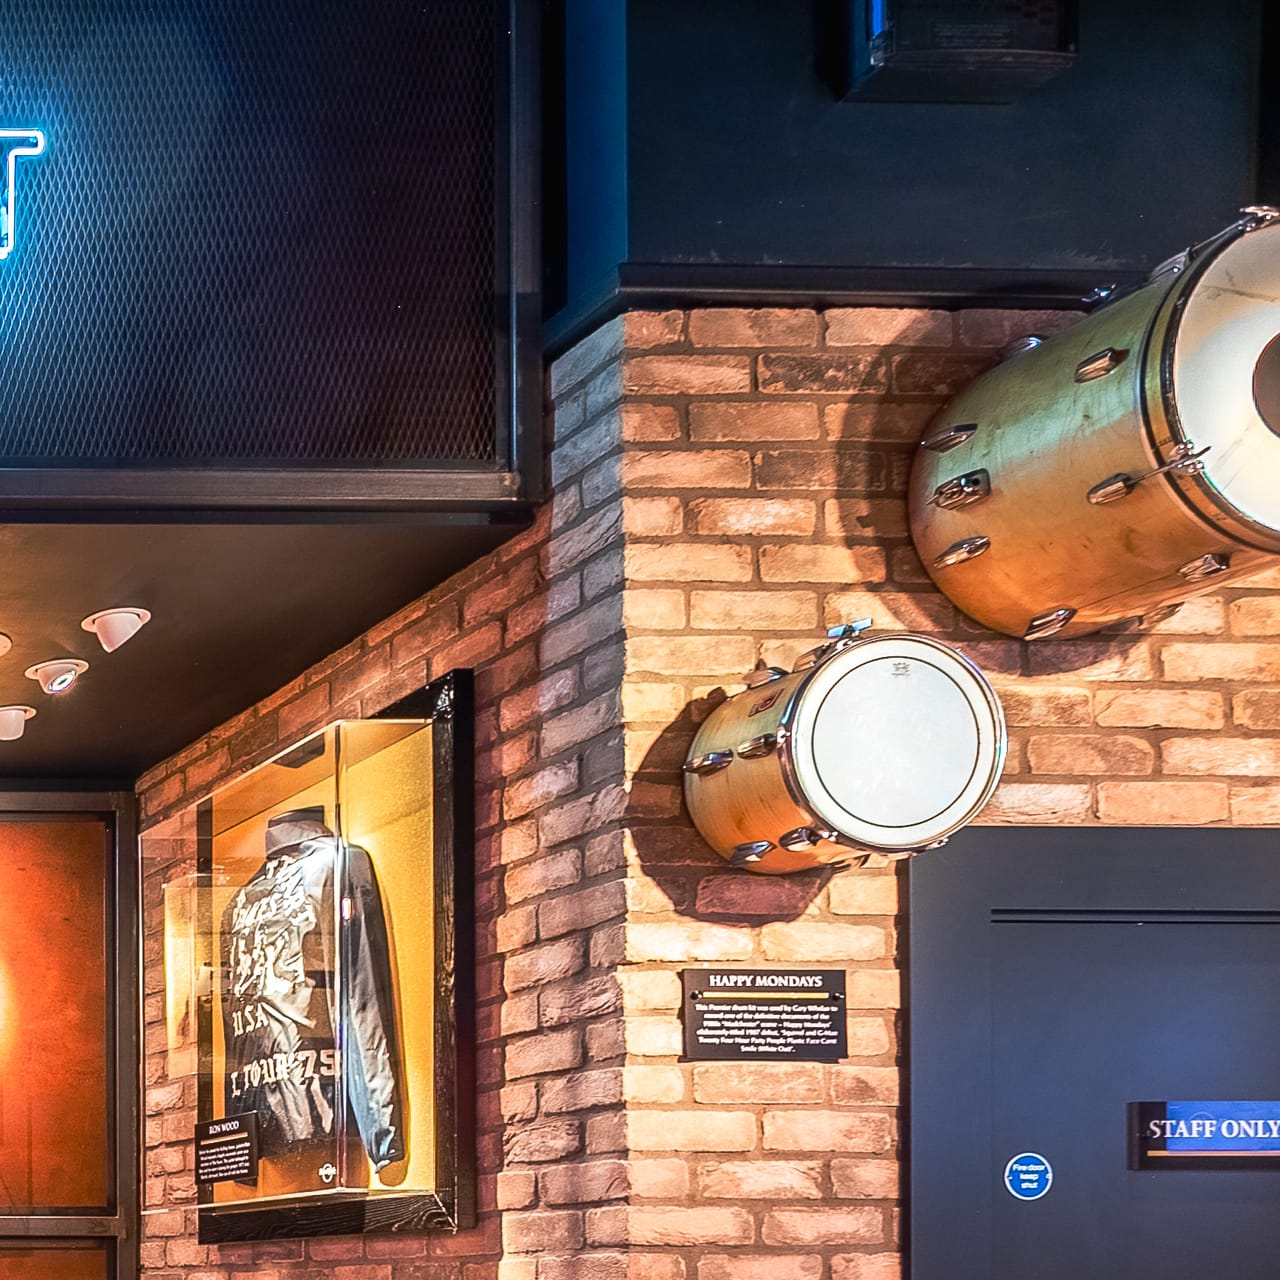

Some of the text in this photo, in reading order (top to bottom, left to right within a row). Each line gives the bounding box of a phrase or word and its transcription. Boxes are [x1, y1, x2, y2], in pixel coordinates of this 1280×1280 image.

[709, 975, 823, 988] HAPPY MONDAYS
[232, 1002, 268, 1037] USA
[243, 1051, 289, 1092] TOUR
[208, 1120, 240, 1135] RON WOOD
[1149, 1119, 1280, 1138] STAFF ONLY
